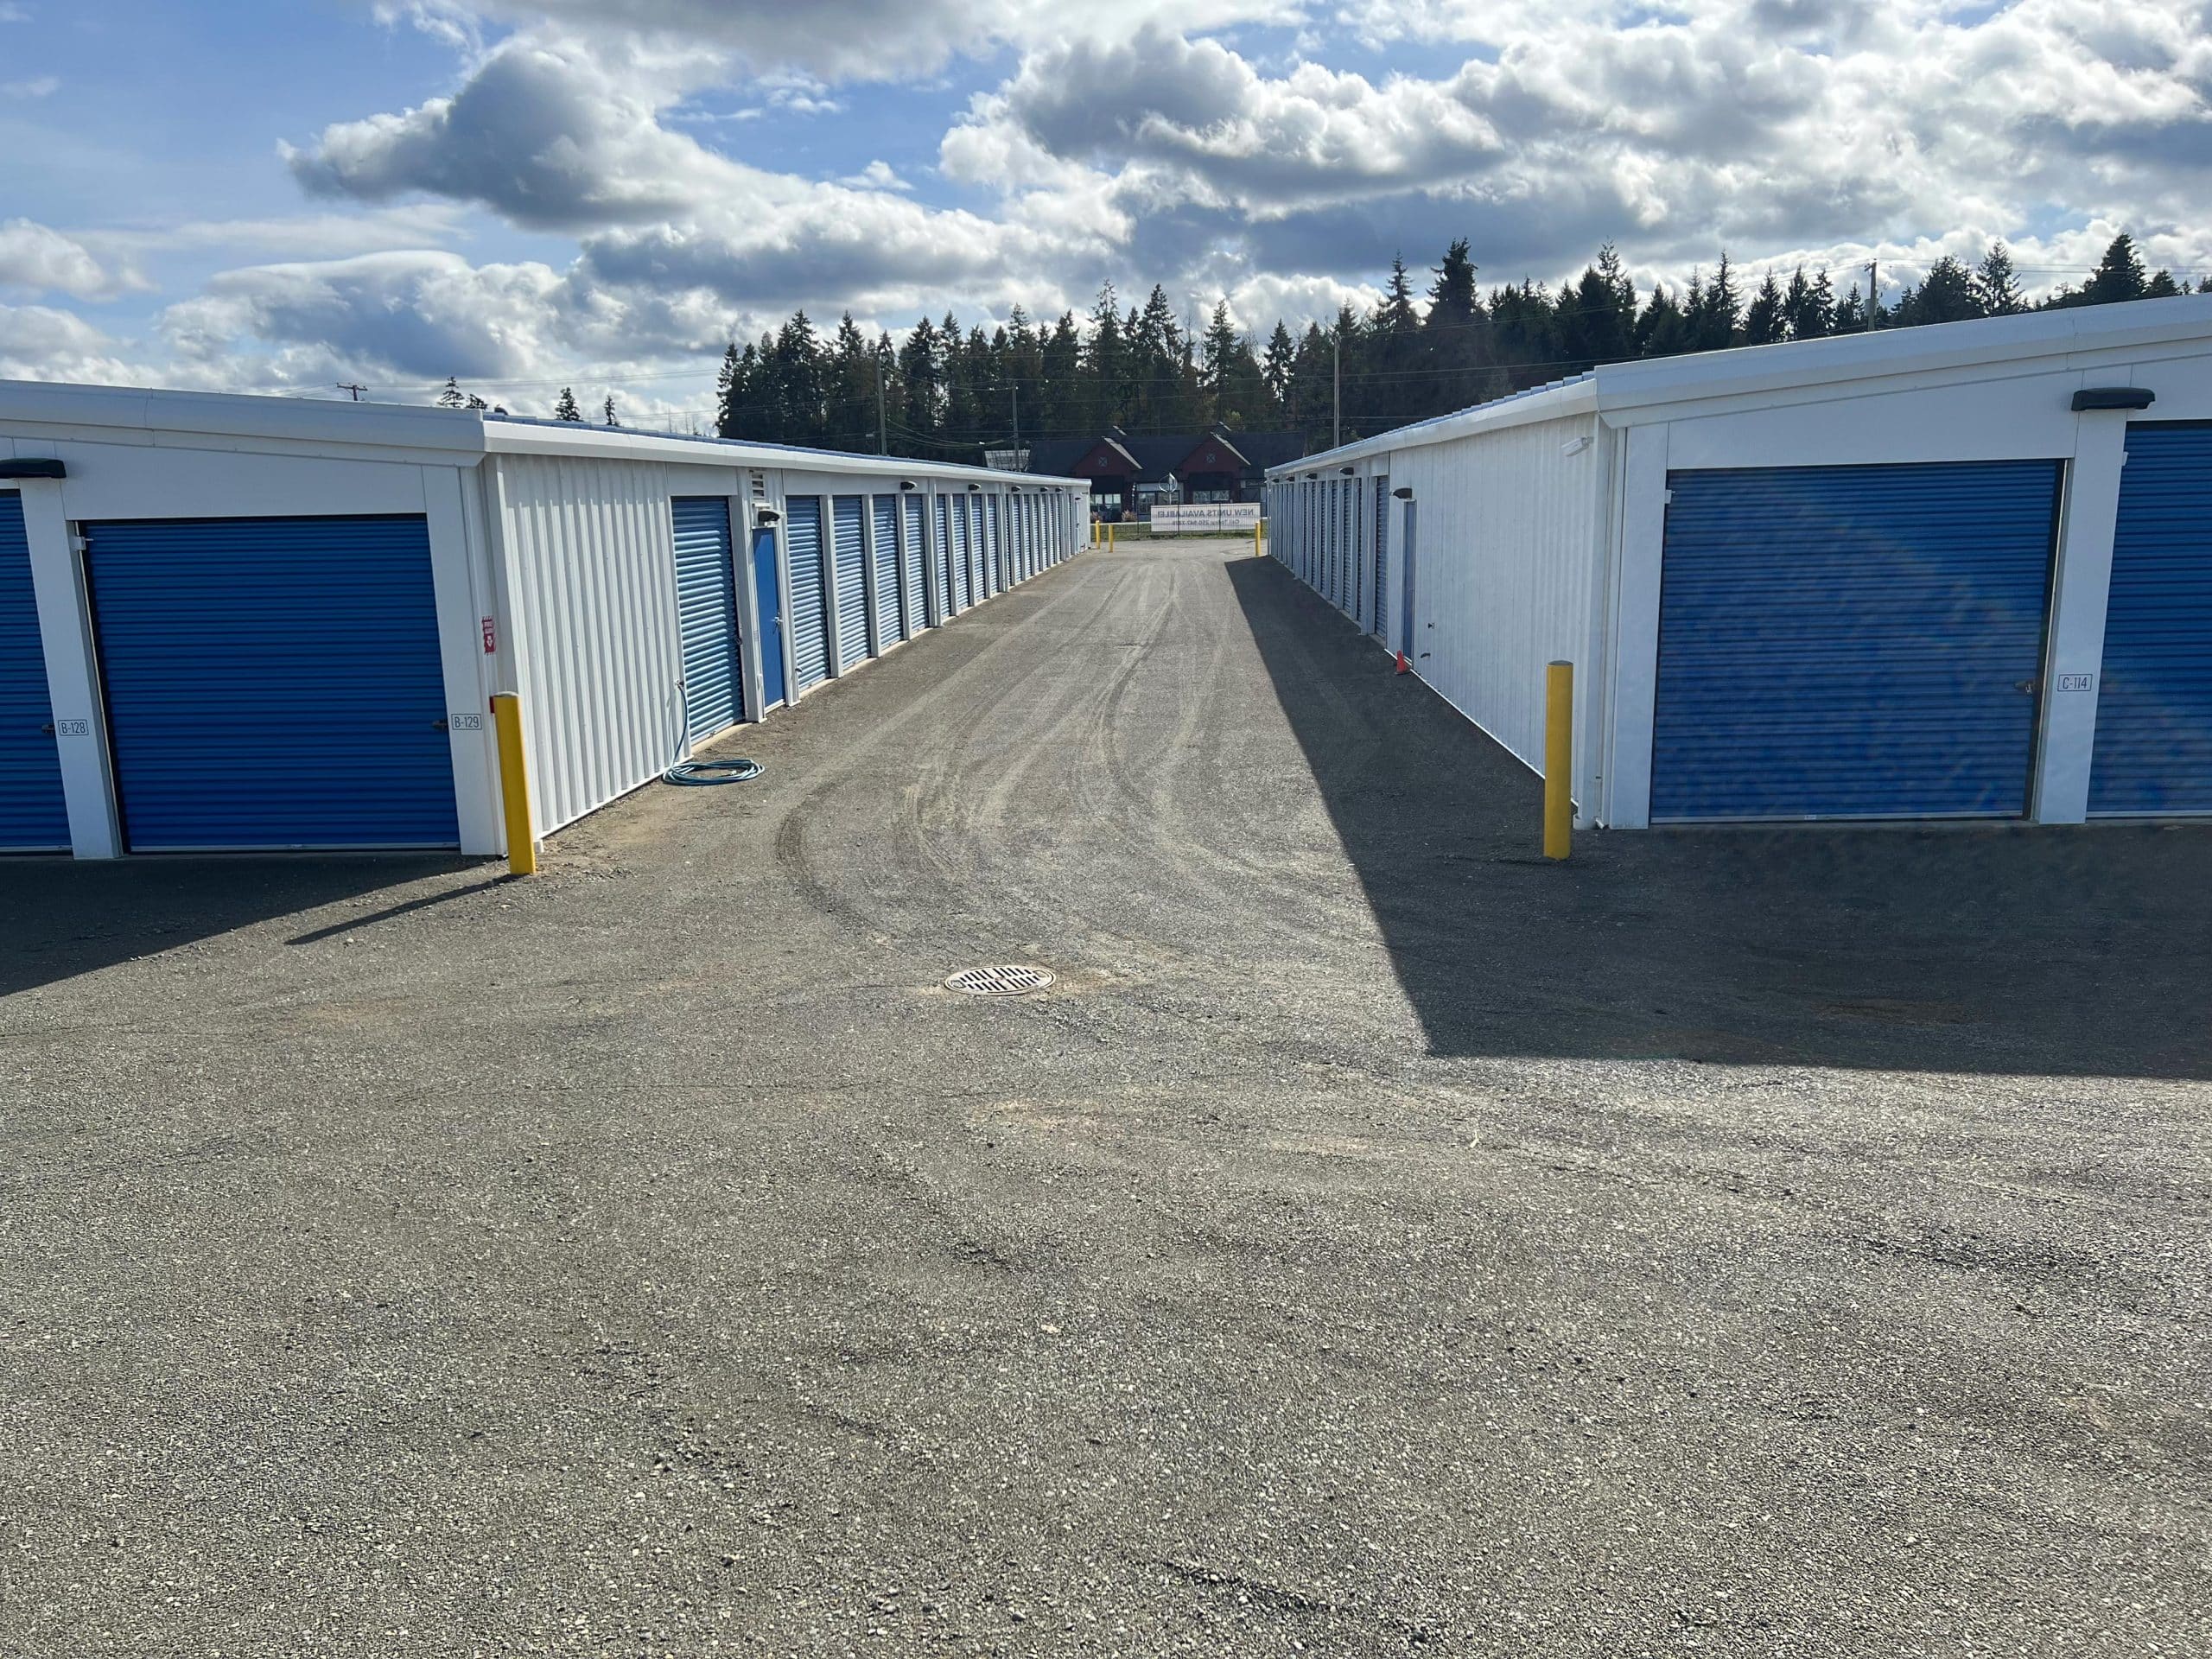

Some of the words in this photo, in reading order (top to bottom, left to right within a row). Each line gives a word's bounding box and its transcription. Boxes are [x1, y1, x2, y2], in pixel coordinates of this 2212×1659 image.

[2063, 677, 2088, 690] C-114
[60, 721, 86, 734] B-128
[454, 716, 480, 728] B-129
